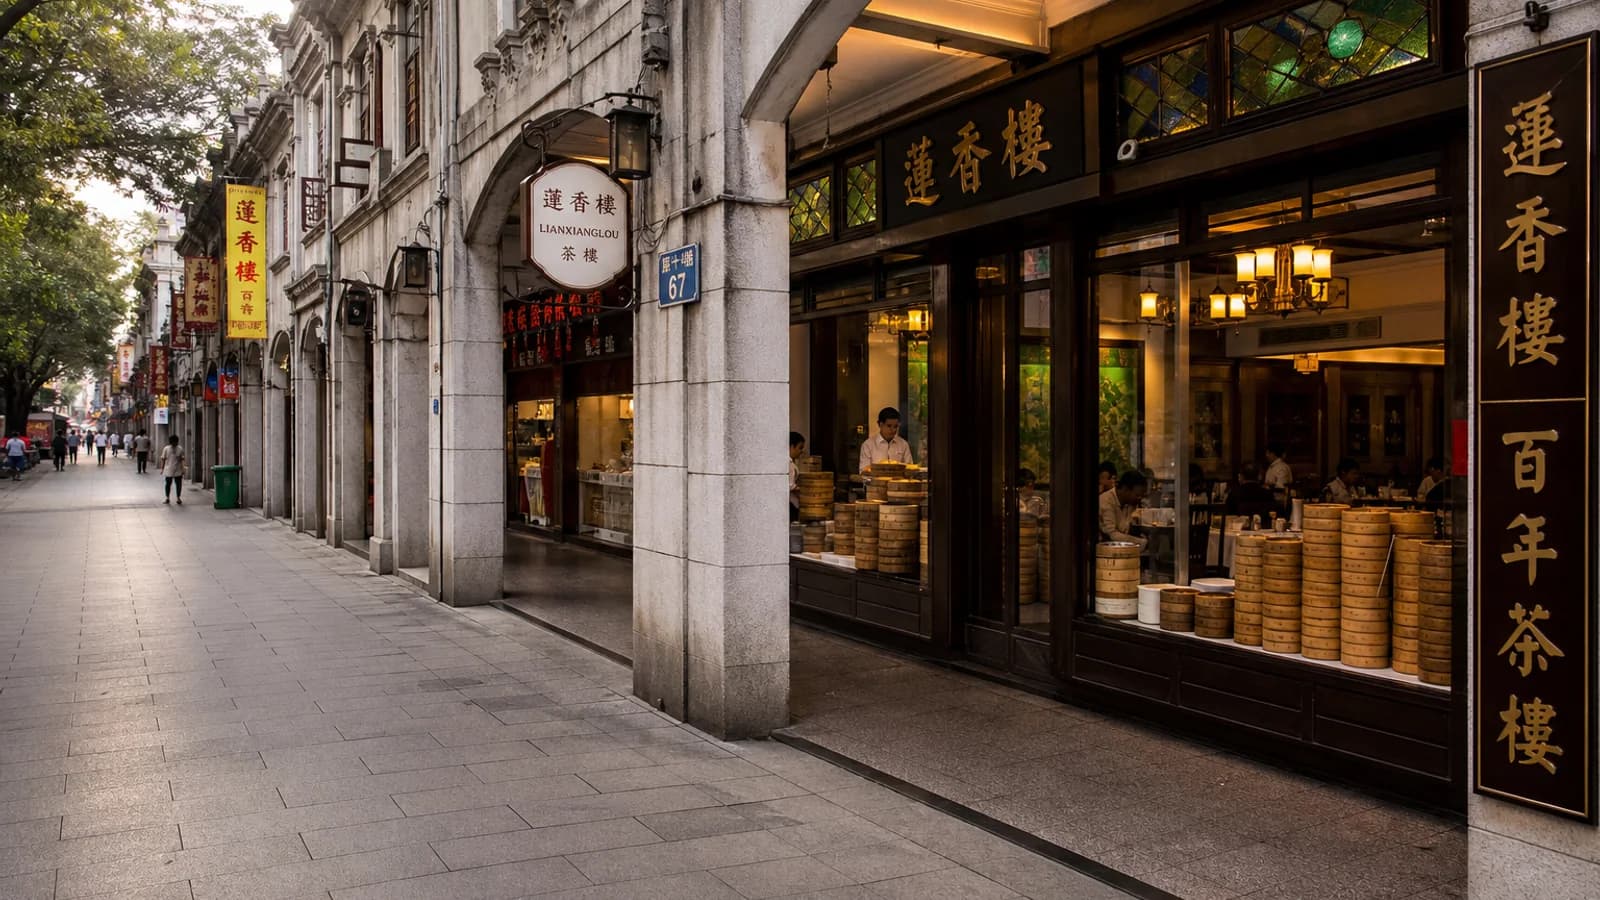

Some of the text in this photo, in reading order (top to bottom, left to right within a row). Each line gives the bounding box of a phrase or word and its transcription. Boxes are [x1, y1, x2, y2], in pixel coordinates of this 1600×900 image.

[904, 100, 1053, 207] 蓮香樓
[543, 187, 617, 216] 蓮香樓
[235, 199, 259, 283] 蓮香樓
[539, 223, 619, 239] LIANXIANGLOU
[561, 245, 598, 264] 茶樓
[668, 272, 686, 300] 67
[1496, 428, 1565, 775] 百年茶樓
